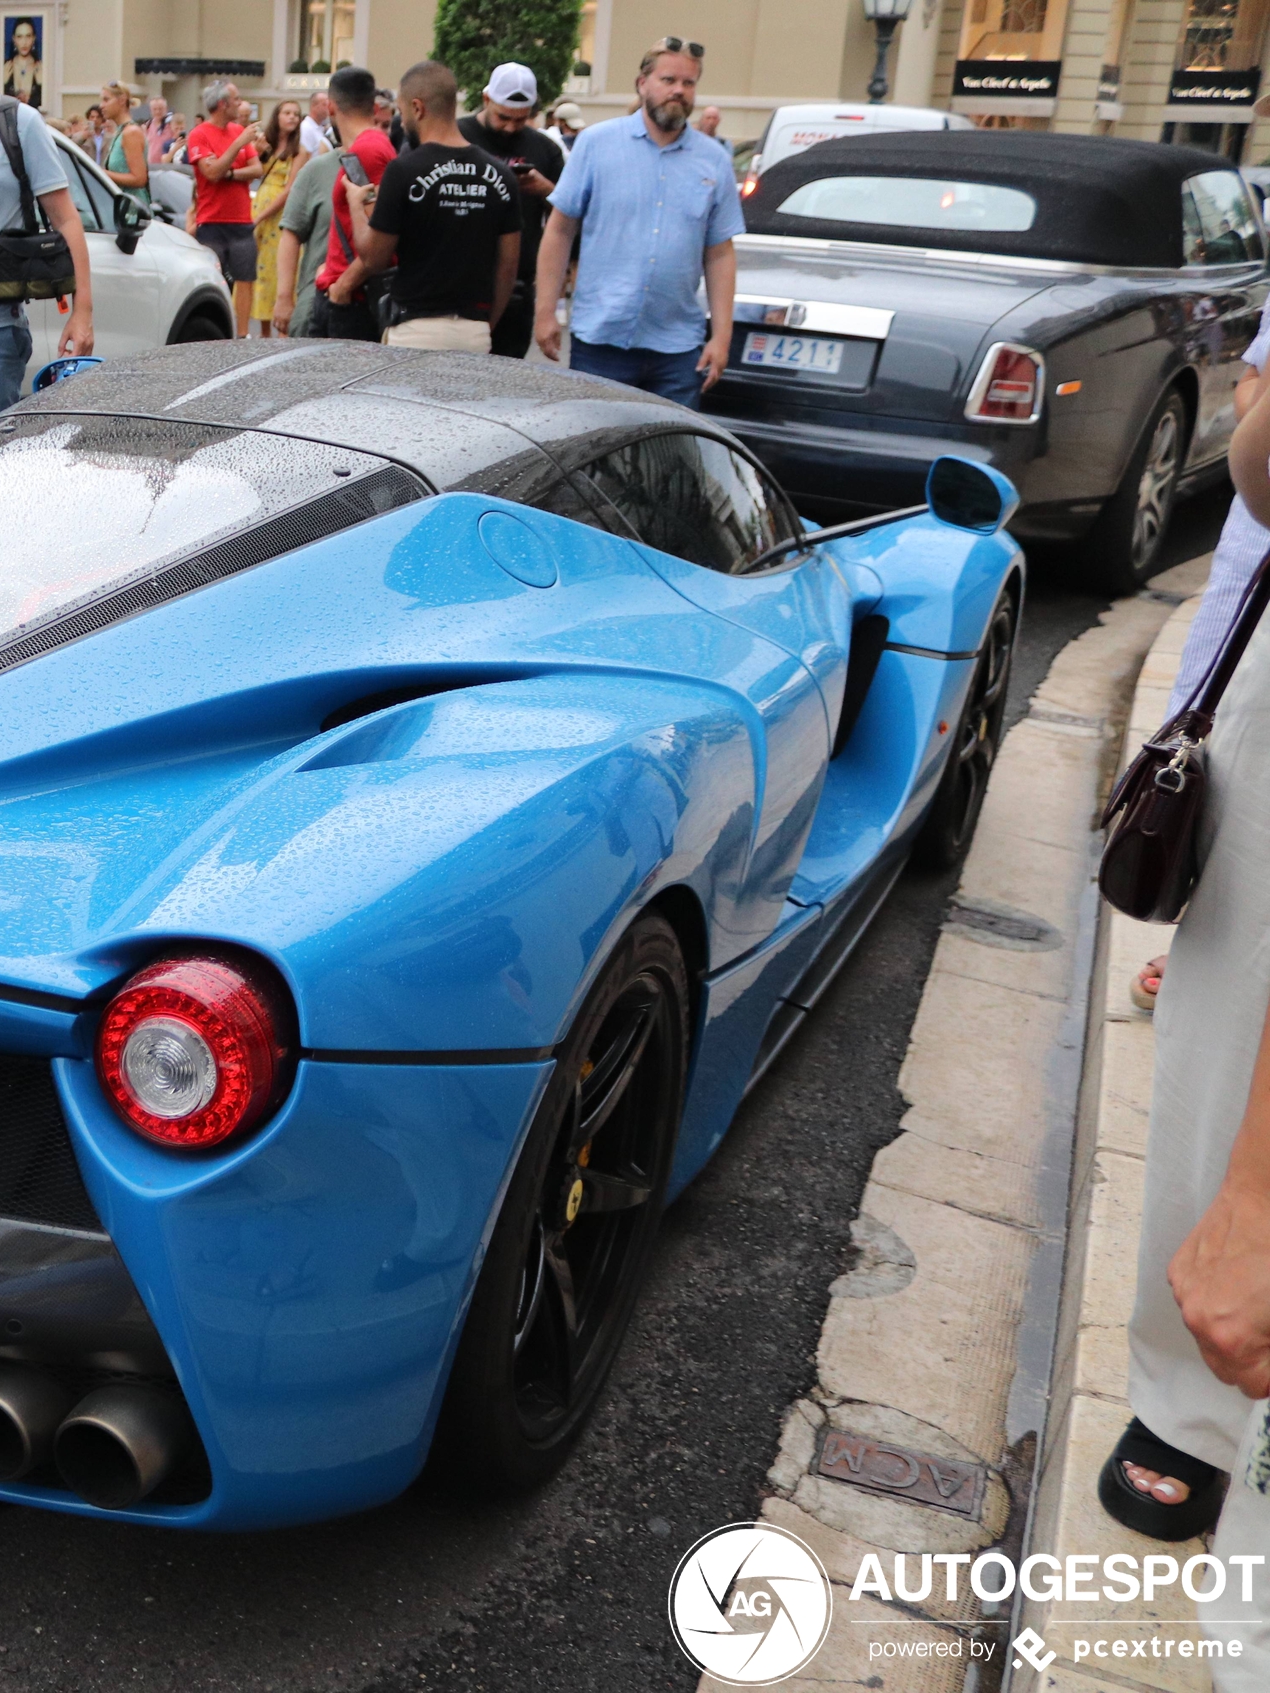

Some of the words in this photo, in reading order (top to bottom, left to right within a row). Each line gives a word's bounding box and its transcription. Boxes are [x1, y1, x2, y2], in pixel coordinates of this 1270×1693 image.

[409, 159, 476, 202] Christian
[482, 163, 511, 202] Dior
[439, 183, 487, 197] ATELIER
[772, 337, 835, 366] 4211
